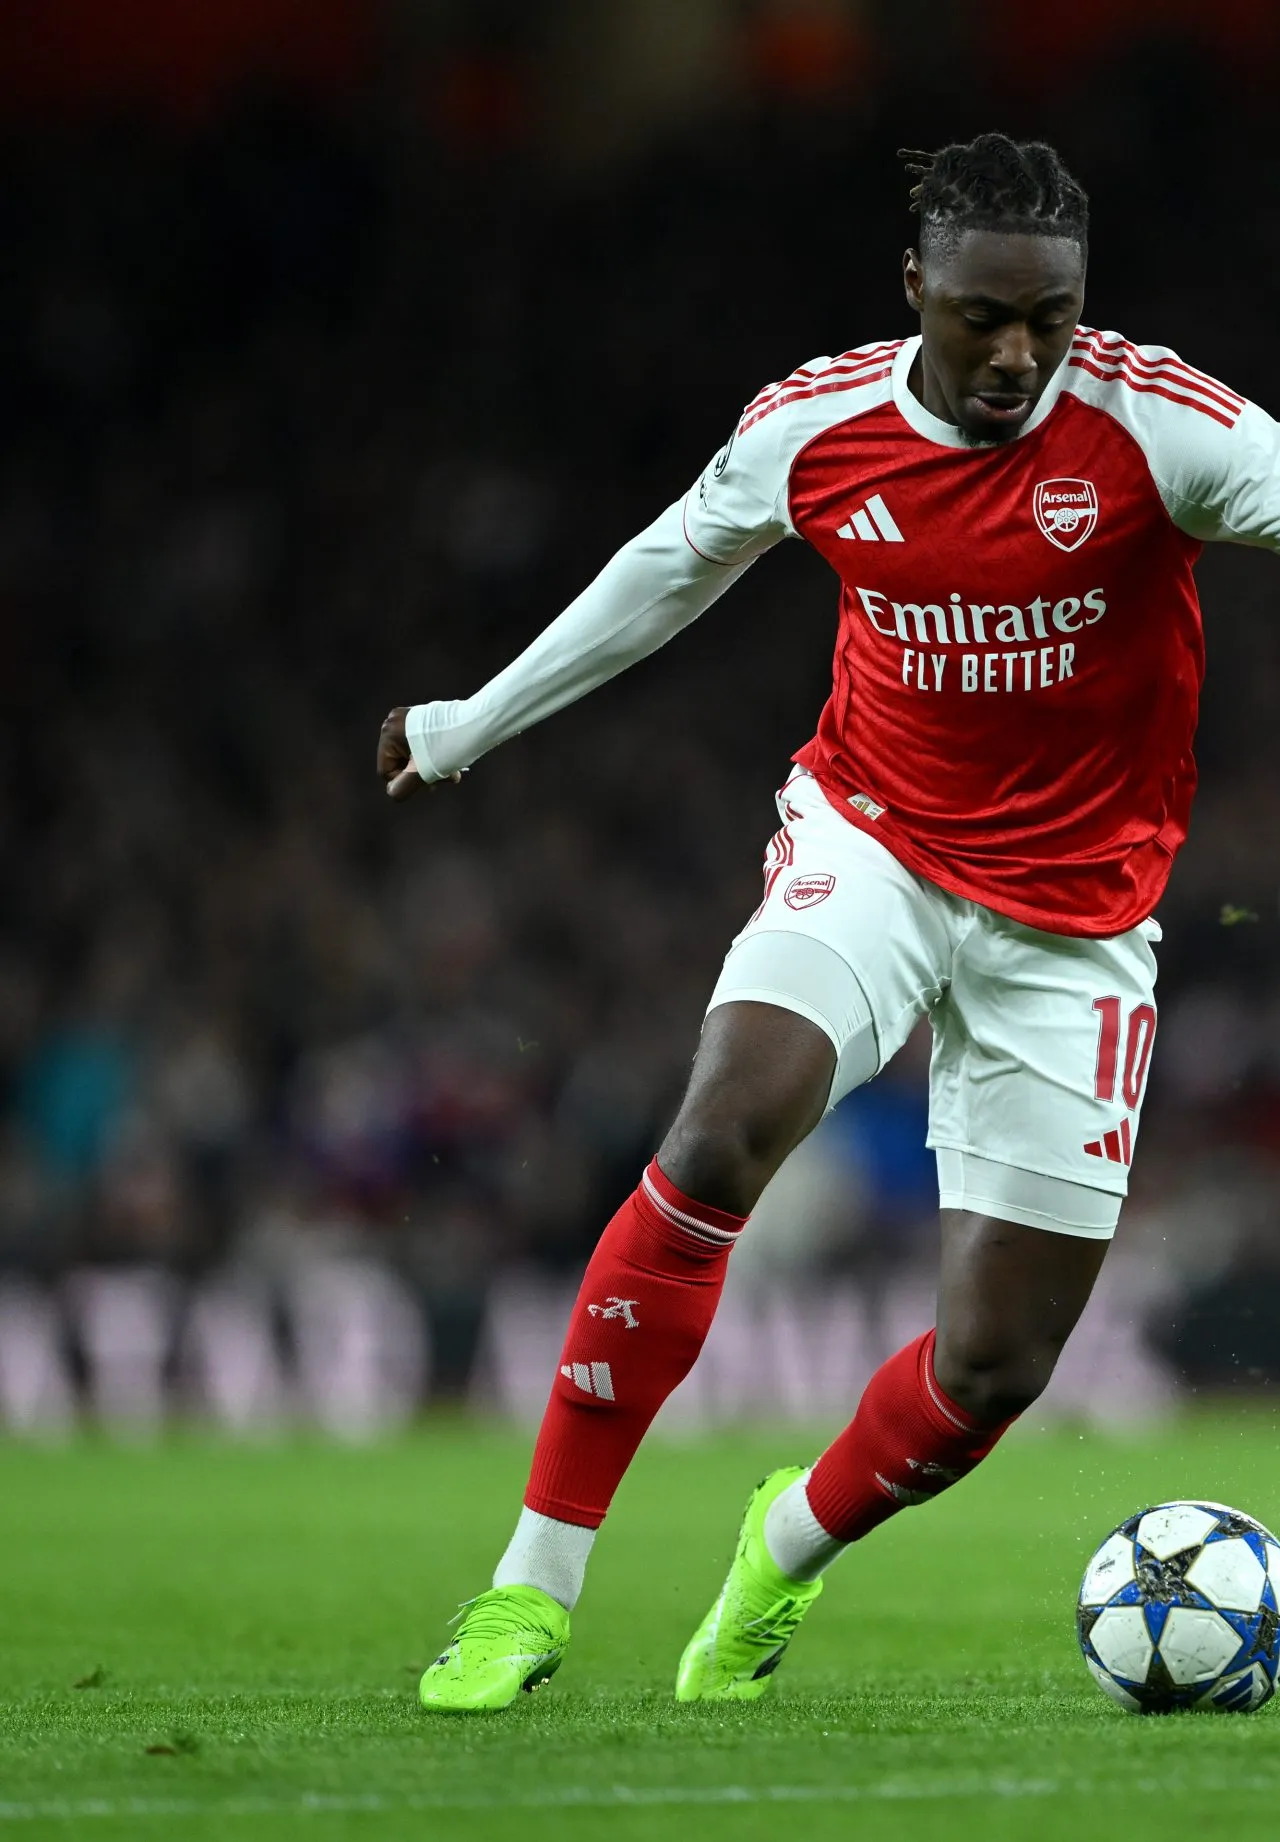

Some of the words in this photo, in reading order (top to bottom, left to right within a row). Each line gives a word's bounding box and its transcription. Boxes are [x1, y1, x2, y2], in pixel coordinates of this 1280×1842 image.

[1042, 490, 1089, 504] Arsenal
[855, 586, 1107, 644] Emirates
[902, 647, 947, 692] FLY
[961, 642, 1076, 693] BETTER
[1092, 994, 1158, 1112] 10
